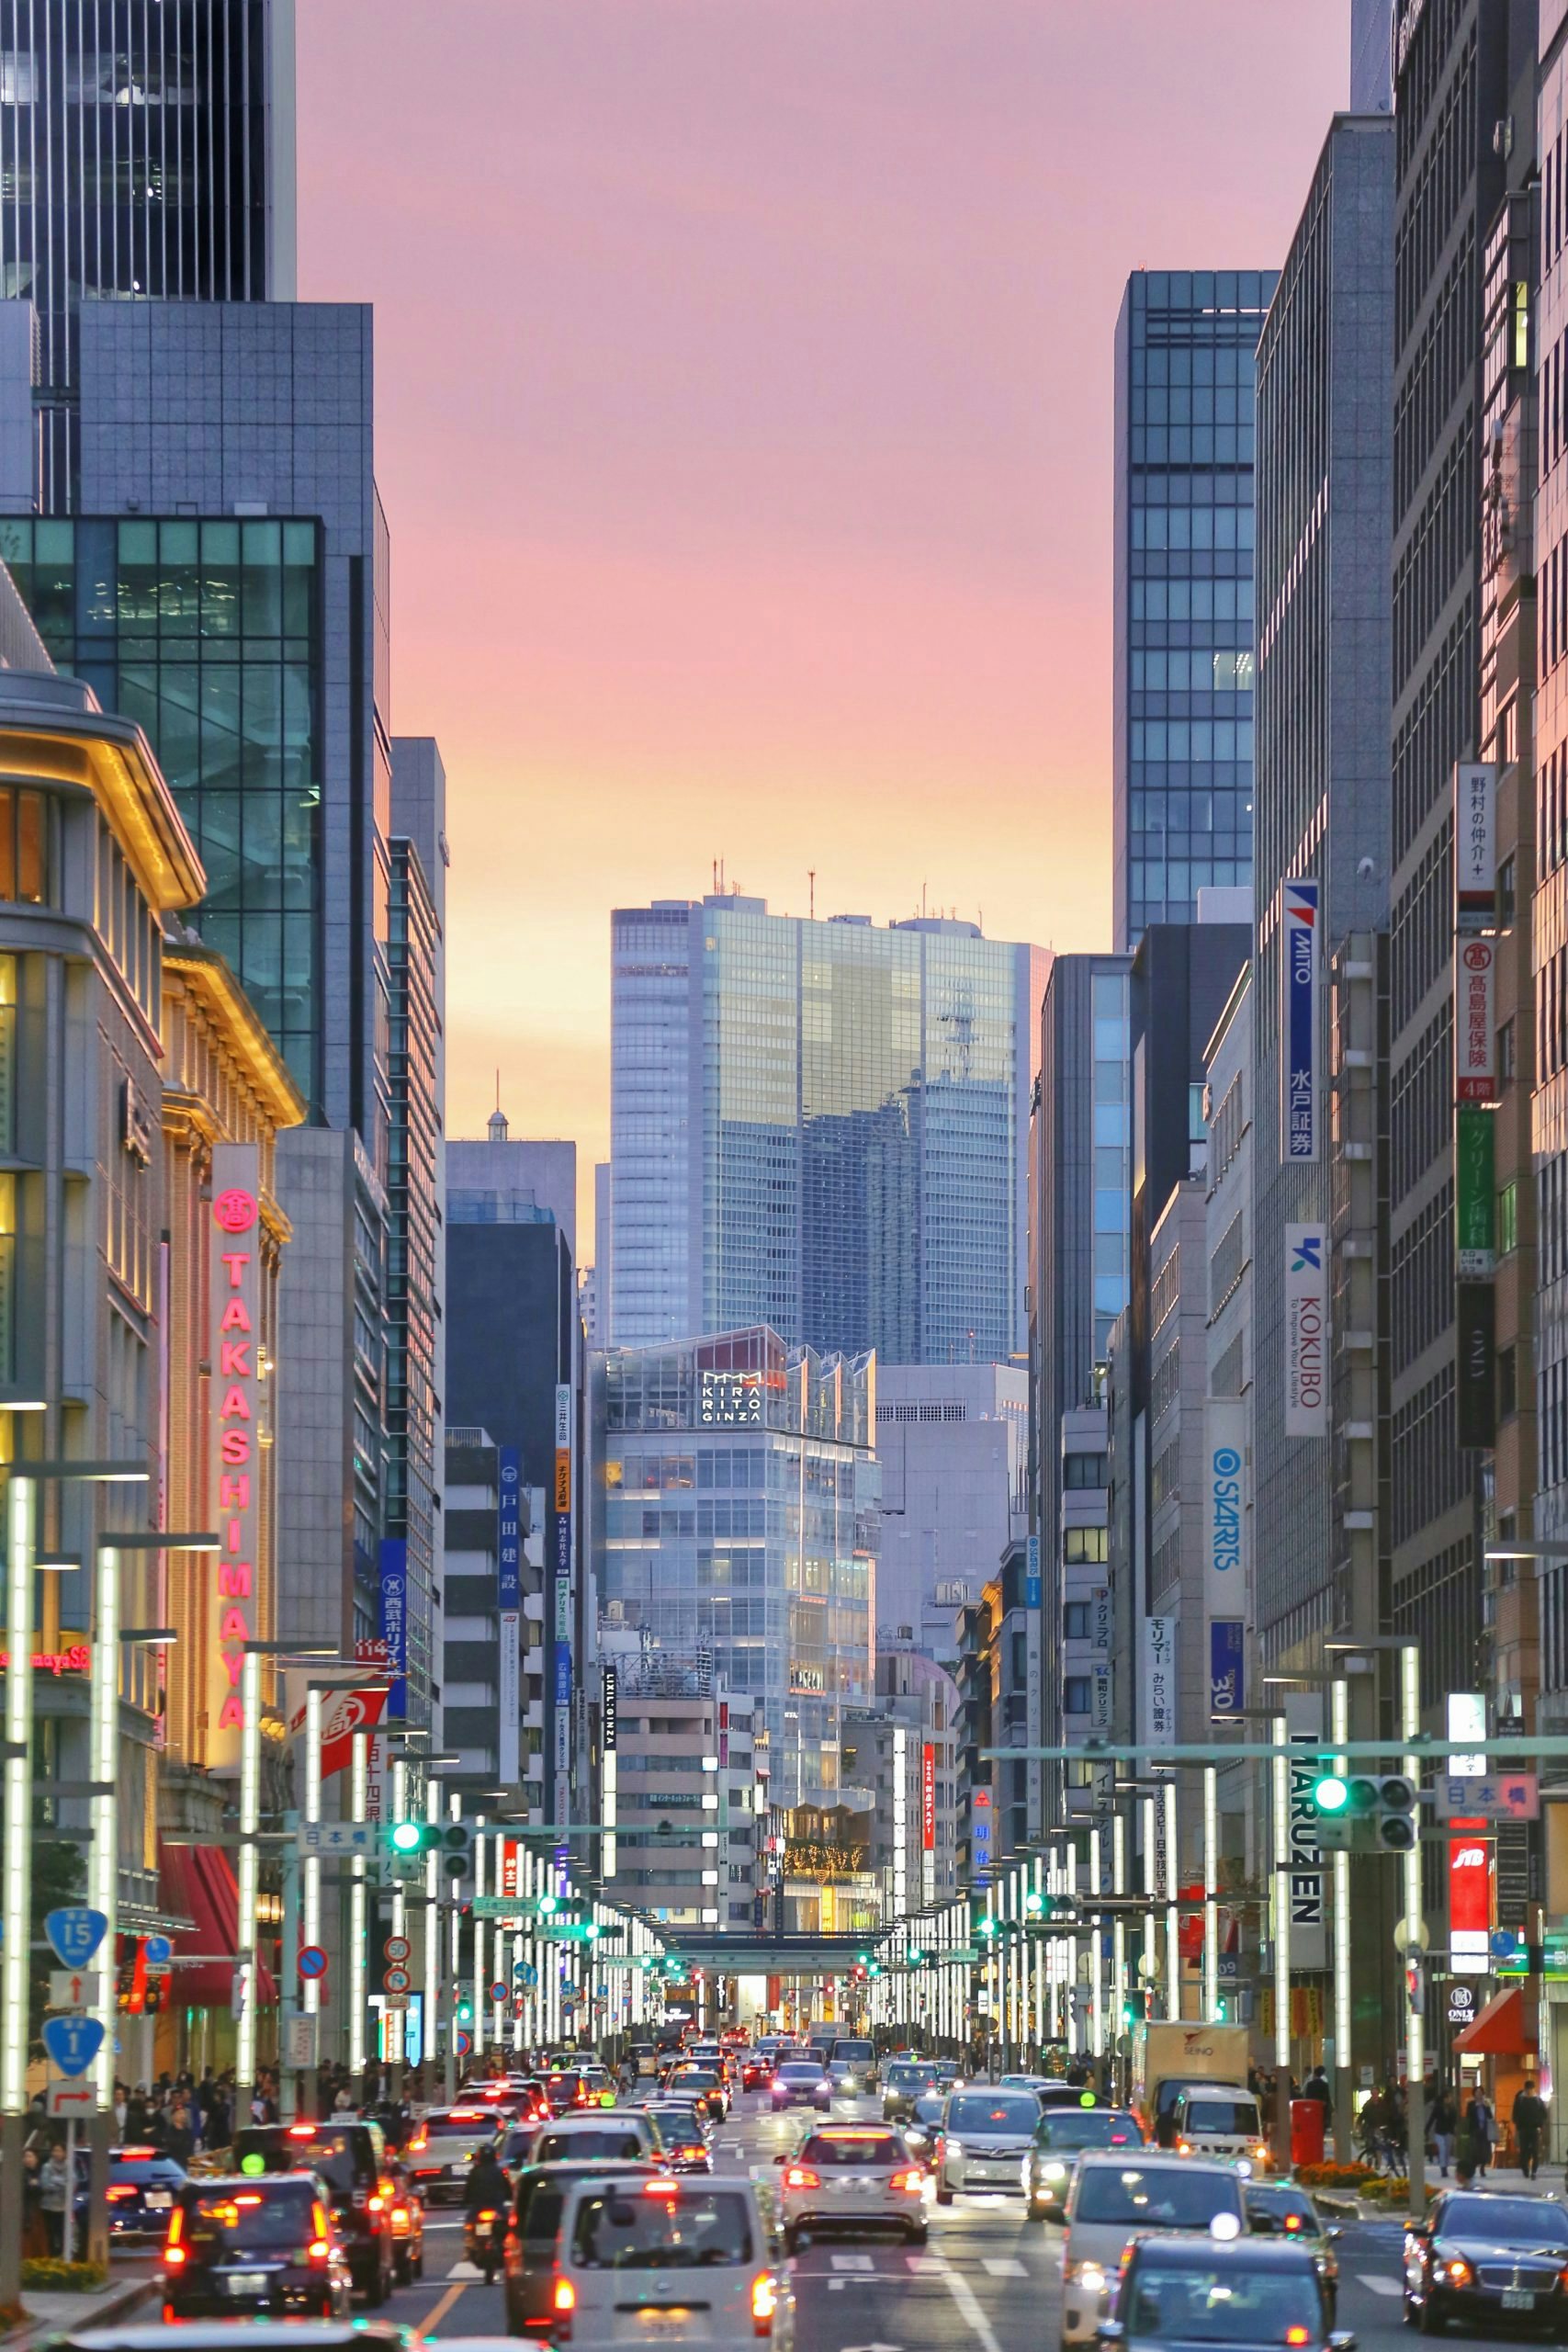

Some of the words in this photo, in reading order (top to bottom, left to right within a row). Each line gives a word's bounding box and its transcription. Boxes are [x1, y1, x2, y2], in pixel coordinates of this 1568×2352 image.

[1294, 933, 1312, 985] MITO
[1291, 1069, 1312, 1155] 水戸証券
[1469, 1130, 1487, 1248] グリーン歯科
[1291, 1298, 1299, 1309] To
[1290, 1311, 1298, 1346] Improve
[1291, 1349, 1299, 1367] Your
[1300, 1297, 1322, 1408] KOKUBO
[703, 1387, 761, 1397] KIRA
[703, 1399, 761, 1409] RITO
[1290, 1371, 1299, 1408] Lifestyle
[558, 1402, 568, 1441] 三井生命
[703, 1412, 761, 1421] GINZA
[218, 1252, 252, 1730] TAKASHIMAYA
[502, 1493, 517, 1590] 戸田建設
[1213, 1479, 1240, 1571] STARTS
[558, 1527, 567, 1566] 同志社大学
[1097, 1604, 1109, 1647] クリニプロ
[1151, 1619, 1165, 1664] モリマー
[1448, 1787, 1526, 1804] 日本橋
[306, 1830, 367, 1846] 日本橋
[1290, 1735, 1321, 1925] MARUZEN
[1156, 1839, 1168, 1900] 日本技研工業
[1452, 1849, 1485, 1870] JTB
[63, 1923, 92, 1946] 15
[389, 1943, 405, 1956] 50
[1448, 2008, 1475, 2018] ONLY
[68, 2031, 79, 2055] 1
